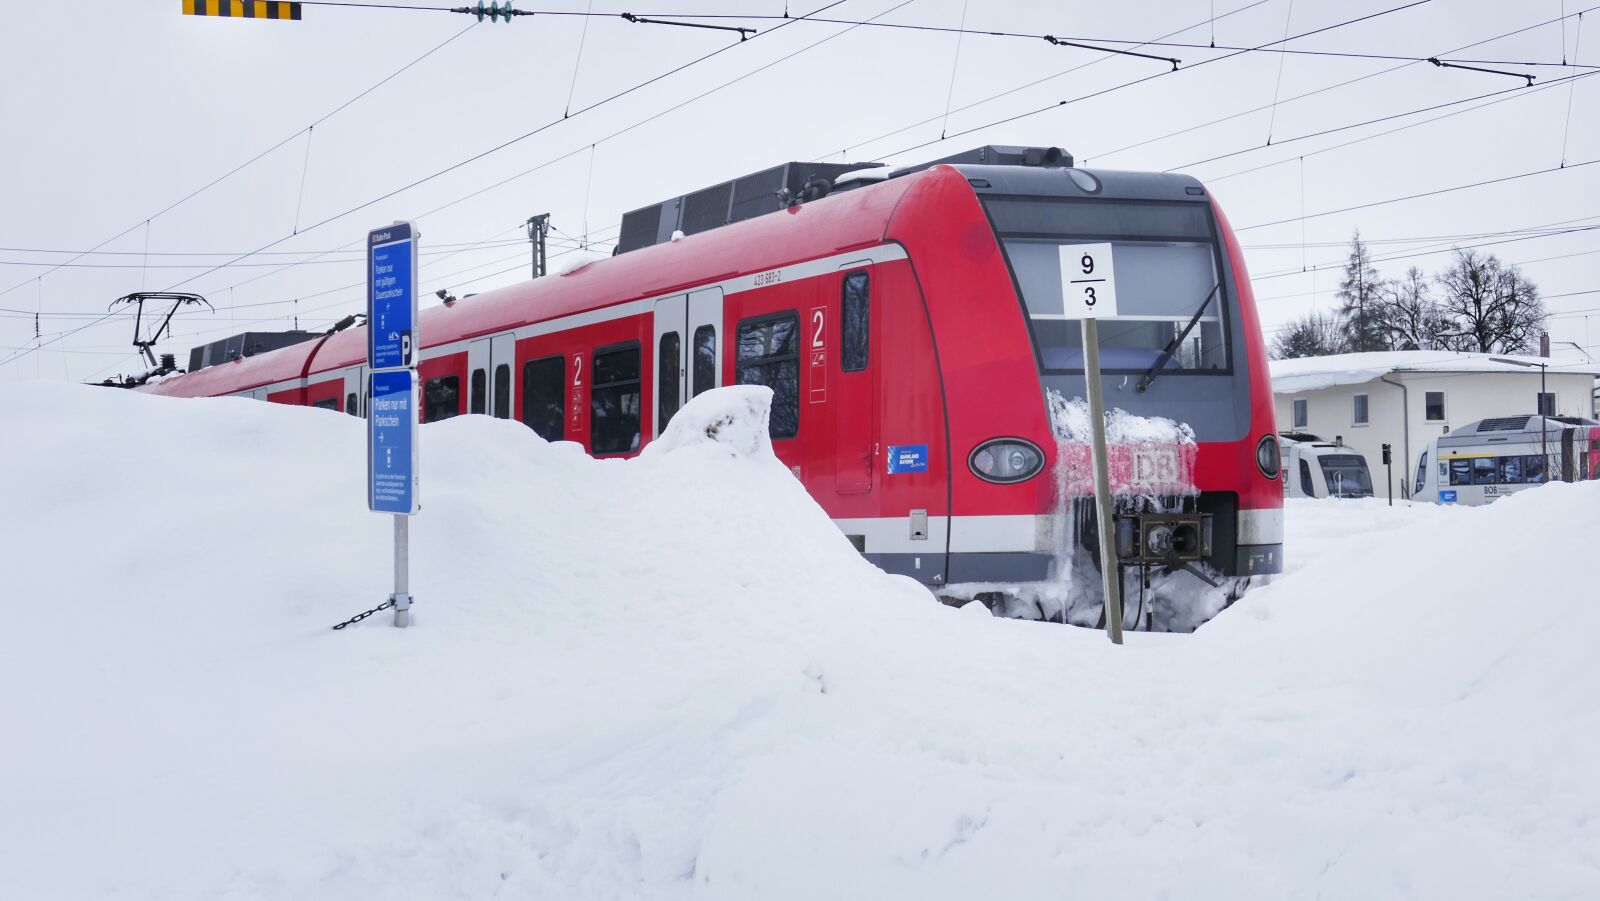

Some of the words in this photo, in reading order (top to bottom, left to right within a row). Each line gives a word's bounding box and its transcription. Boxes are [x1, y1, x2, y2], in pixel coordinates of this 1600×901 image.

[1081, 254, 1095, 275] 9
[753, 274, 764, 287] 423
[1084, 286, 1097, 307] 3
[812, 310, 824, 348] 2
[402, 335, 410, 367] P
[573, 356, 582, 387] 2
[375, 398, 390, 411] Parken
[391, 399, 399, 411] nur
[399, 397, 407, 410] mit
[375, 414, 400, 428] Parkschein
[874, 442, 880, 455] 2
[1135, 452, 1175, 481] DB
[1484, 485, 1498, 495] BOB
